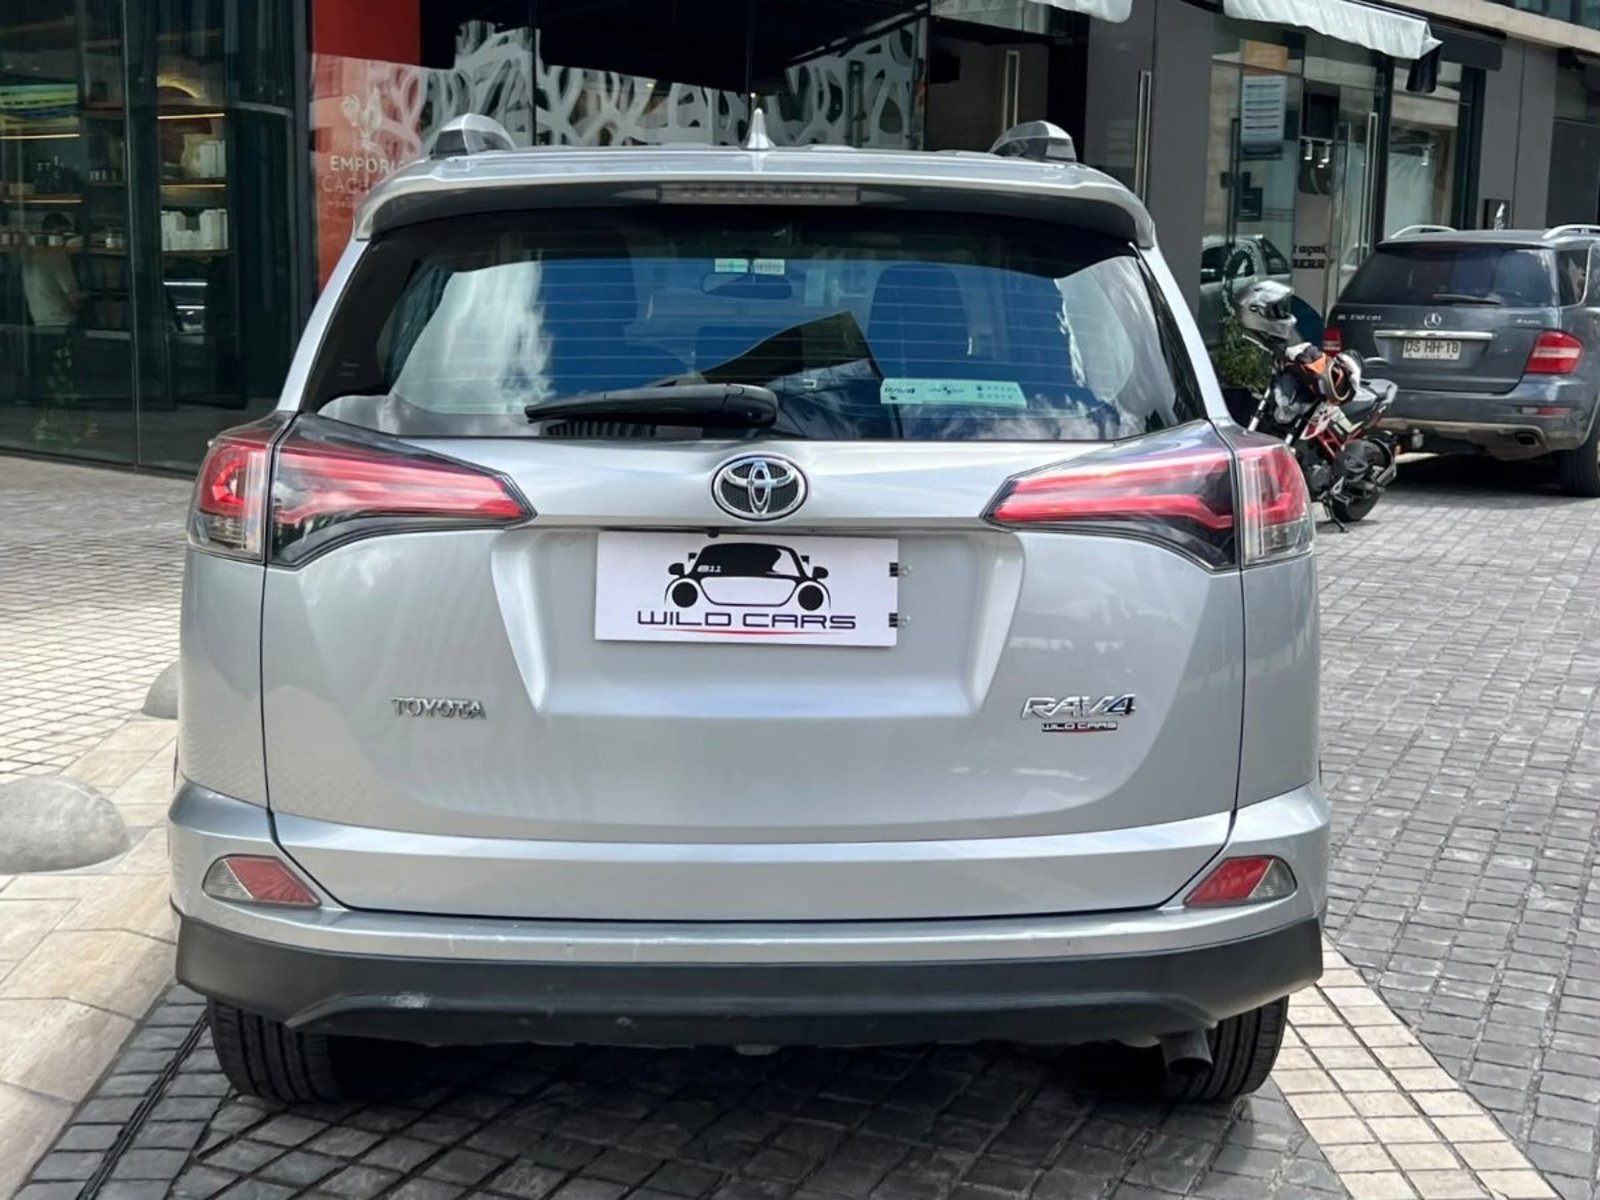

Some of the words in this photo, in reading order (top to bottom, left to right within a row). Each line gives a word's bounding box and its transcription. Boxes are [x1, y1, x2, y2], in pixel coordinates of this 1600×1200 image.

[1405, 339, 1421, 353] DS
[637, 610, 732, 627] WILD
[742, 612, 857, 630] CARS
[389, 696, 486, 719] TOYOTA
[1021, 693, 1137, 718] RAV4
